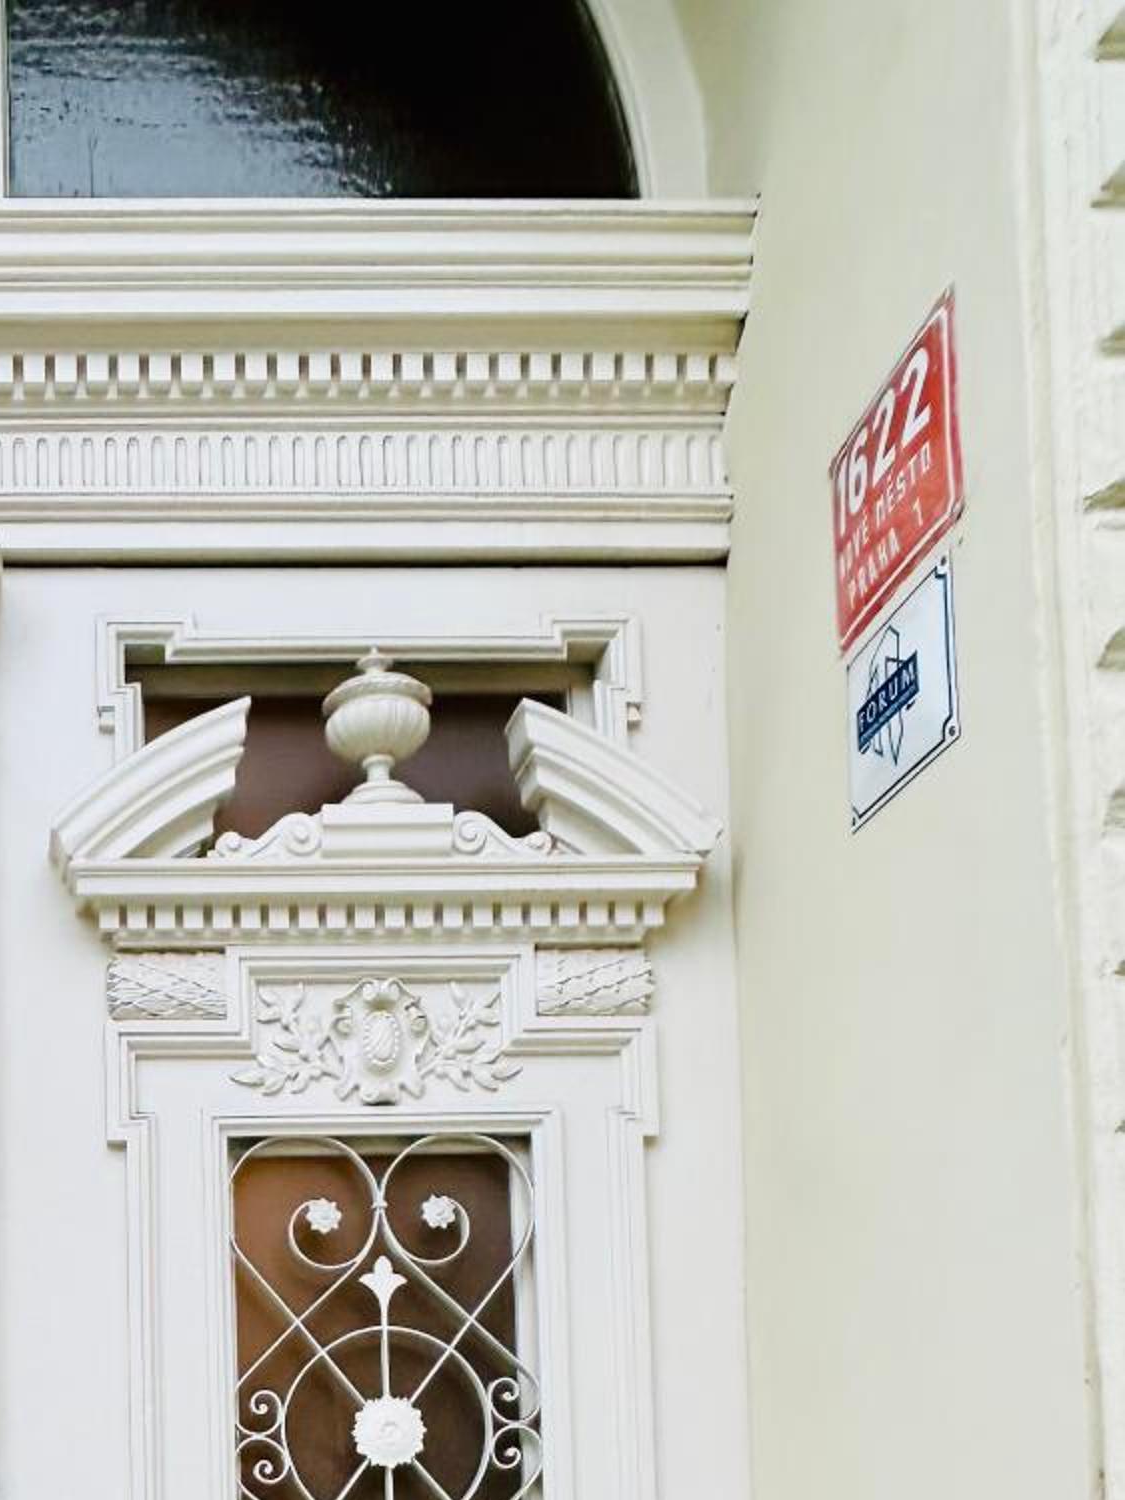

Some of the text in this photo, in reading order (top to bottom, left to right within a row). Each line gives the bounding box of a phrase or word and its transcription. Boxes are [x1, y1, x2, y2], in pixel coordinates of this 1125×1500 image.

[837, 346, 931, 537] 1622
[848, 498, 924, 609] PRAHA 1
[859, 662, 916, 733] FORUM
